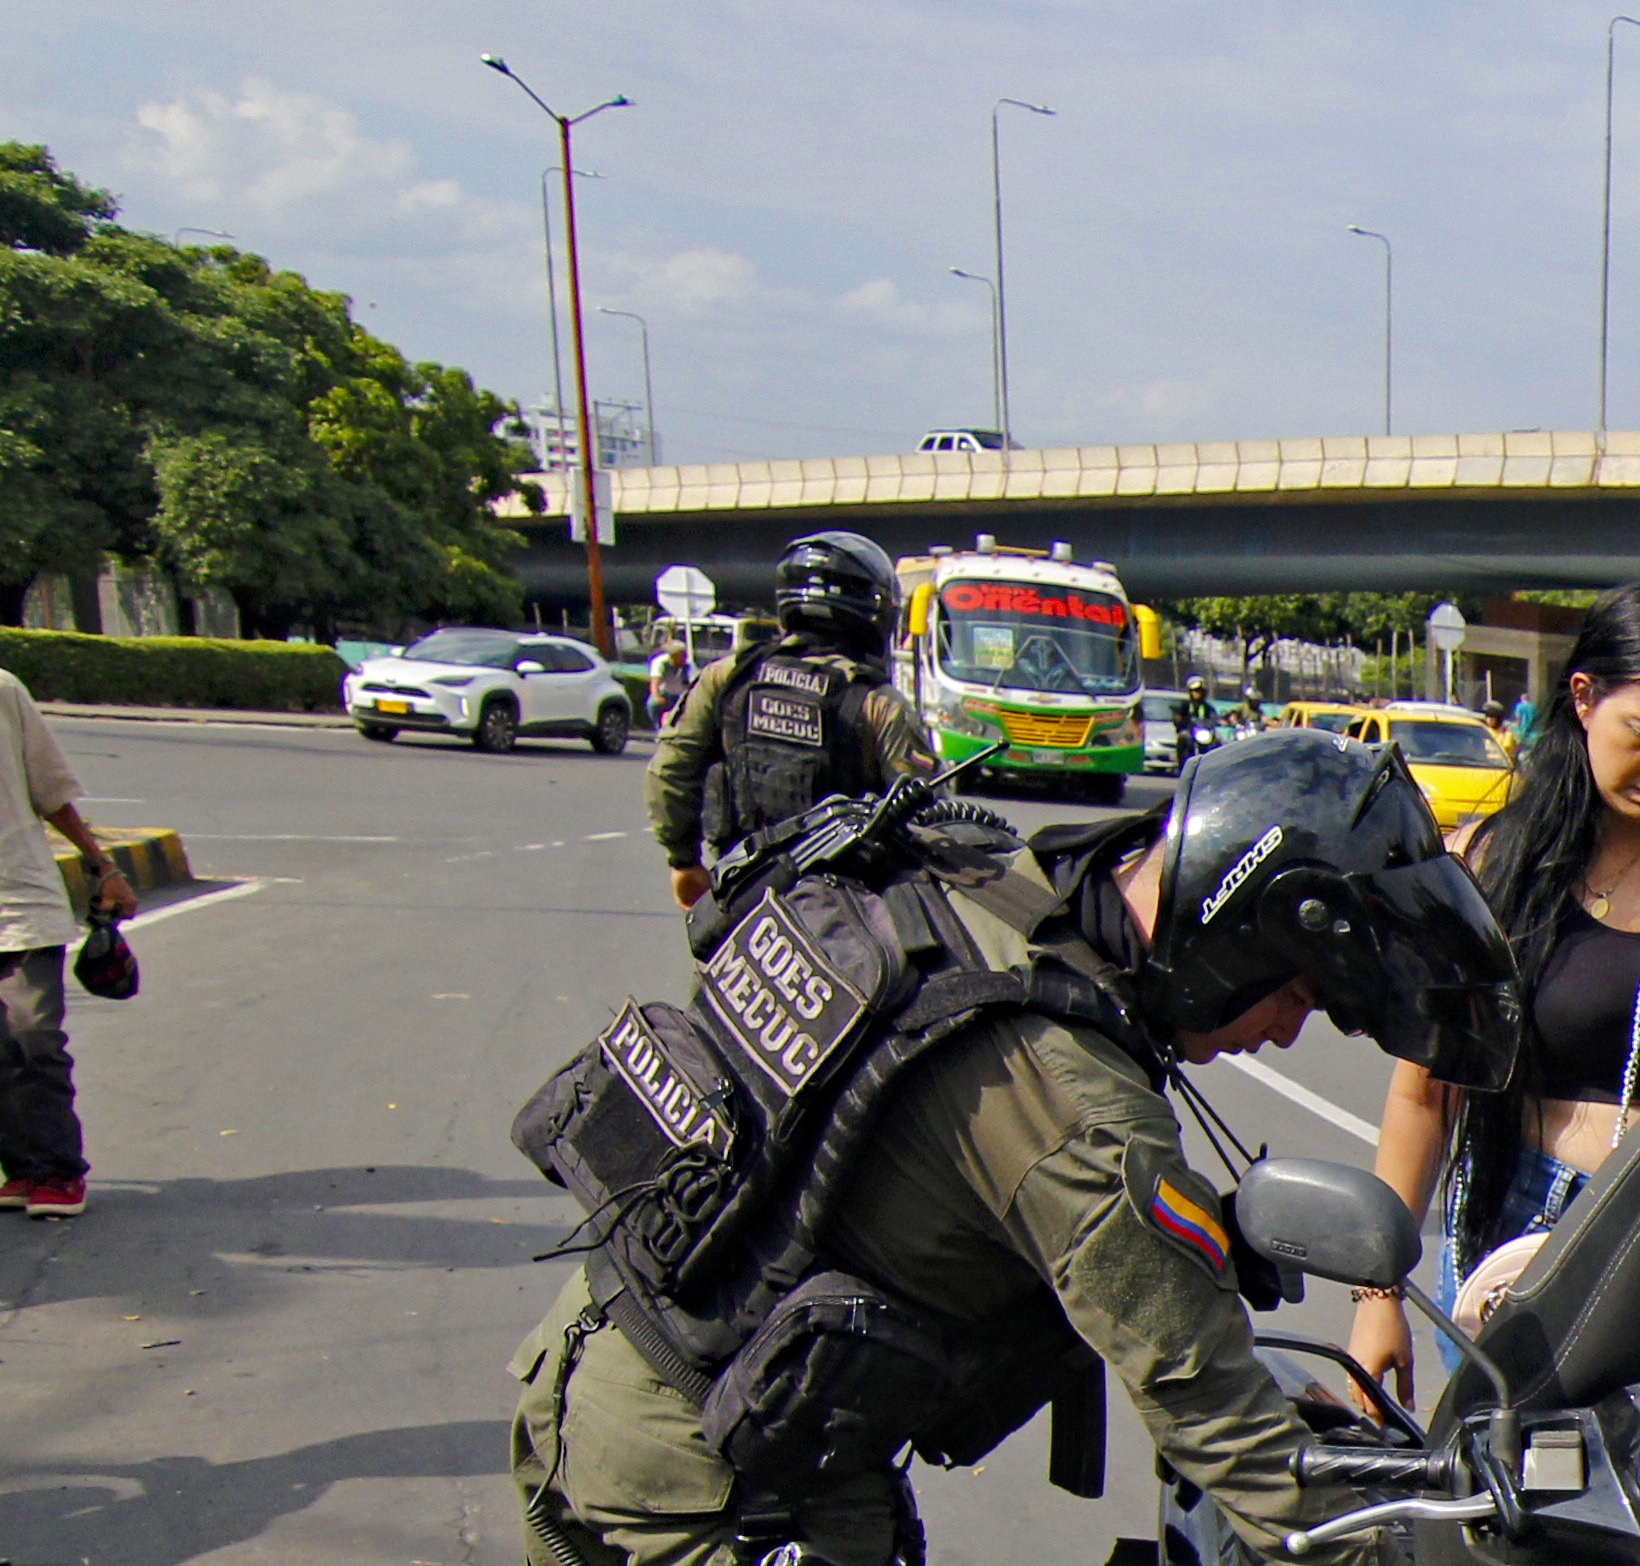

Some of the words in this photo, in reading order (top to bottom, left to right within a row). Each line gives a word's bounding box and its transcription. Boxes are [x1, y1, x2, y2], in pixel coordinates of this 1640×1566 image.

[943, 585, 1126, 629] Oriental
[761, 697, 811, 721] GOES
[763, 666, 822, 694] POLICIA
[749, 915, 834, 1020] GOES
[709, 938, 820, 1076] MECUC
[612, 1011, 718, 1147] POLICIA
